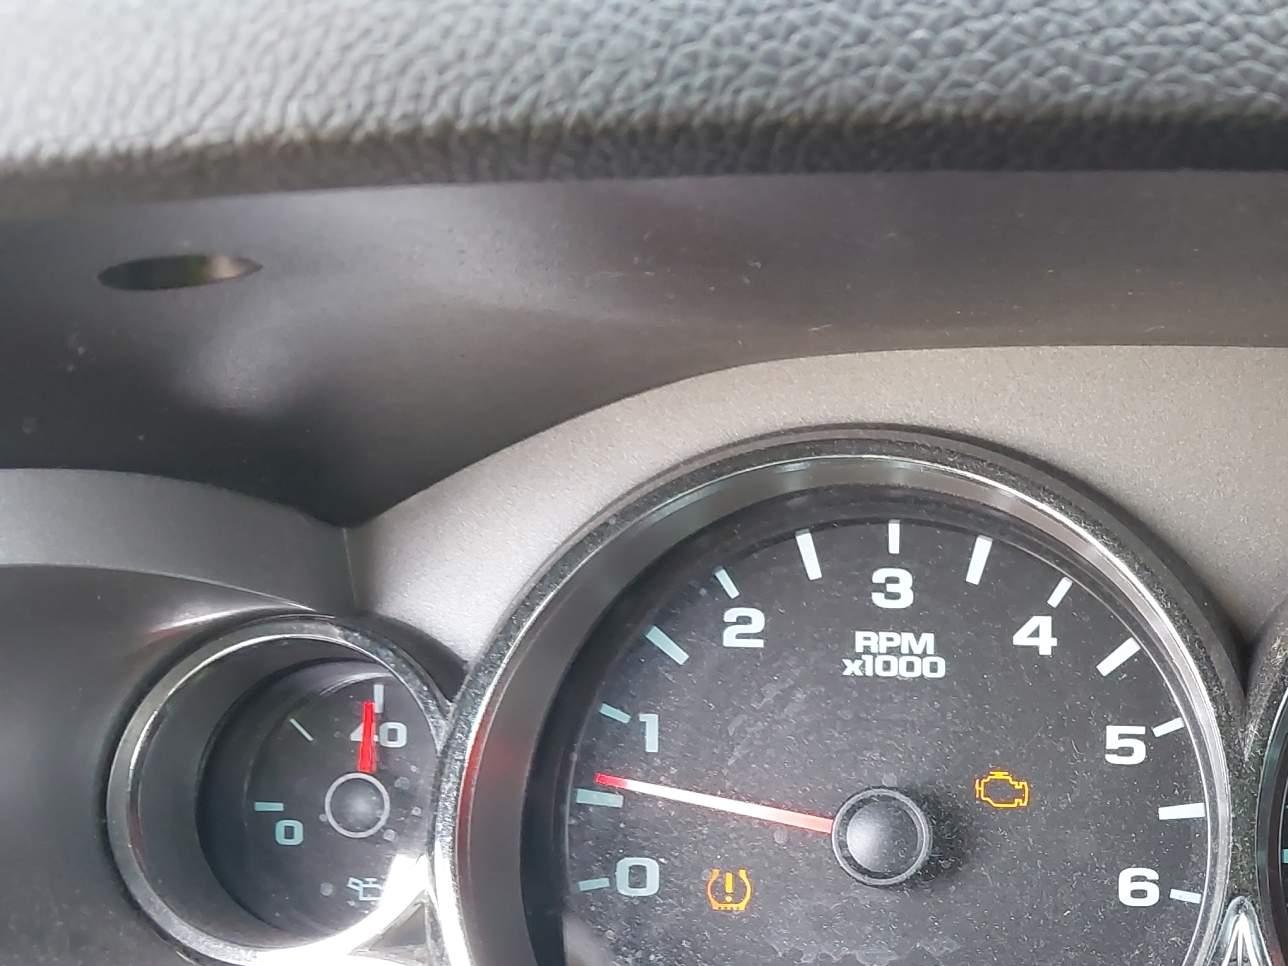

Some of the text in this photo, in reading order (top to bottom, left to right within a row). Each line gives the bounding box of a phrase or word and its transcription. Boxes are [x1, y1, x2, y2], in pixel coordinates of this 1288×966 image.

[871, 567, 914, 609] 3
[722, 607, 766, 648] 2
[854, 631, 934, 655] RPM
[1012, 615, 1058, 656] 4
[841, 655, 946, 679] x1000
[638, 713, 659, 753] 1
[1104, 725, 1147, 765] 5
[275, 819, 304, 846] 0
[615, 856, 660, 897] 0
[1118, 867, 1160, 907] 6
